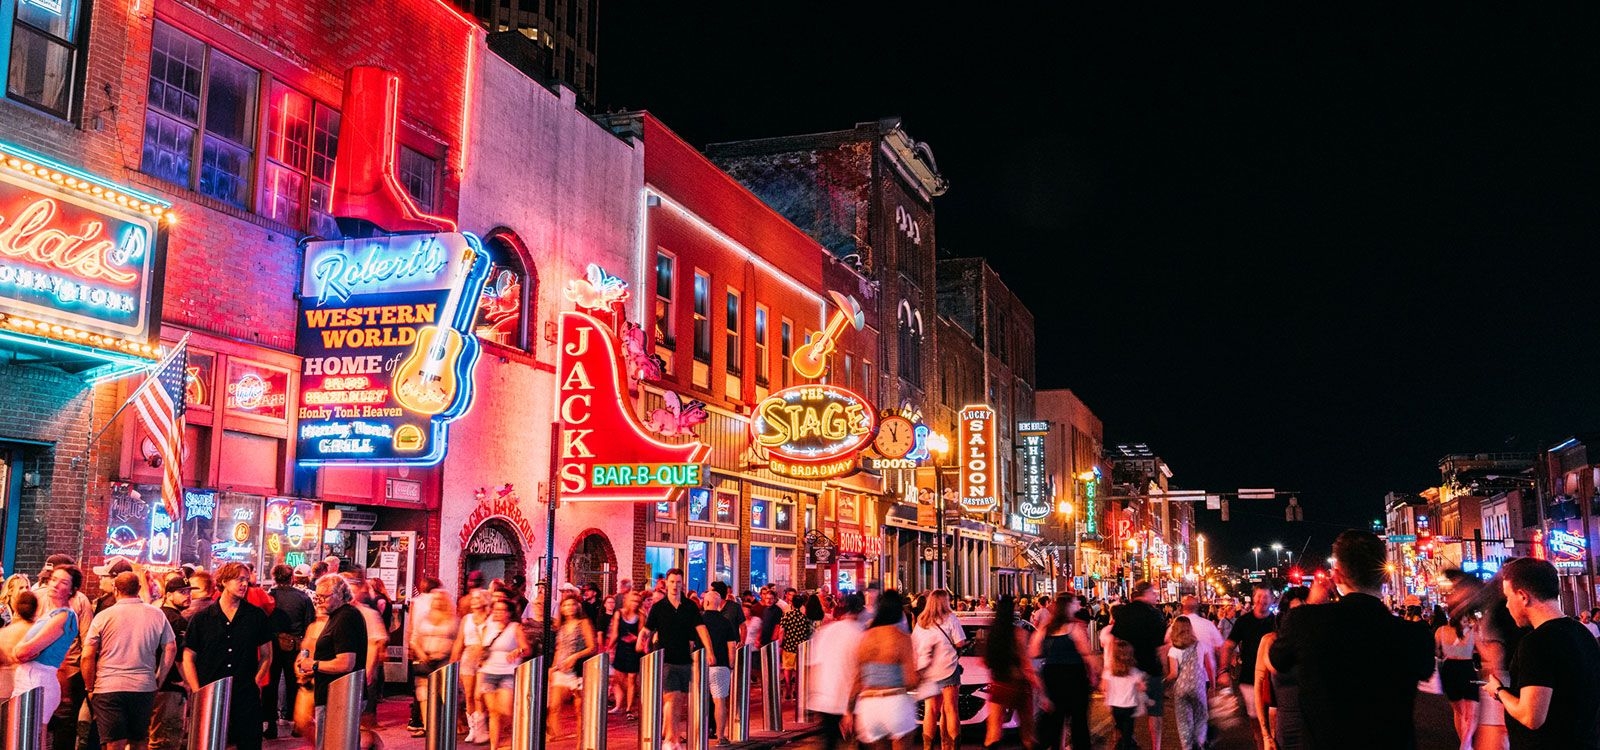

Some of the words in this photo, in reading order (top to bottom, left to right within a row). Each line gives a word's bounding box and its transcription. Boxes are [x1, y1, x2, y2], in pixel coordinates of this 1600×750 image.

[0, 198, 137, 283] la's
[0, 264, 62, 295] ONKY
[314, 238, 447, 305] Robert's
[305, 303, 437, 328] WESTERN
[321, 327, 416, 349] WORLD
[304, 356, 382, 376] HOME
[385, 352, 403, 377] of
[801, 388, 824, 400] THE
[298, 408, 332, 421] Honky
[334, 406, 360, 418] Tonk
[363, 405, 403, 417] Heaven
[560, 326, 596, 493] JACKS
[962, 410, 992, 420] LUCKY
[758, 397, 870, 447] STAGE
[319, 438, 374, 453] GRILL
[770, 461, 785, 474] ON
[791, 459, 852, 476] BROADWAY
[873, 459, 917, 469] BOOTS
[968, 420, 987, 497] SALOON
[592, 465, 699, 486] BAR-B-QUE
[1027, 436, 1040, 504] WHISKEY
[963, 497, 995, 506] BASTARD
[1023, 502, 1047, 517] Row
[233, 508, 253, 520] Tito's
[459, 501, 491, 548] JACK'S
[841, 532, 862, 552] BOOTS
[865, 536, 881, 554] HATS
[1552, 530, 1586, 547] HONKY
[286, 552, 305, 567] ATM
